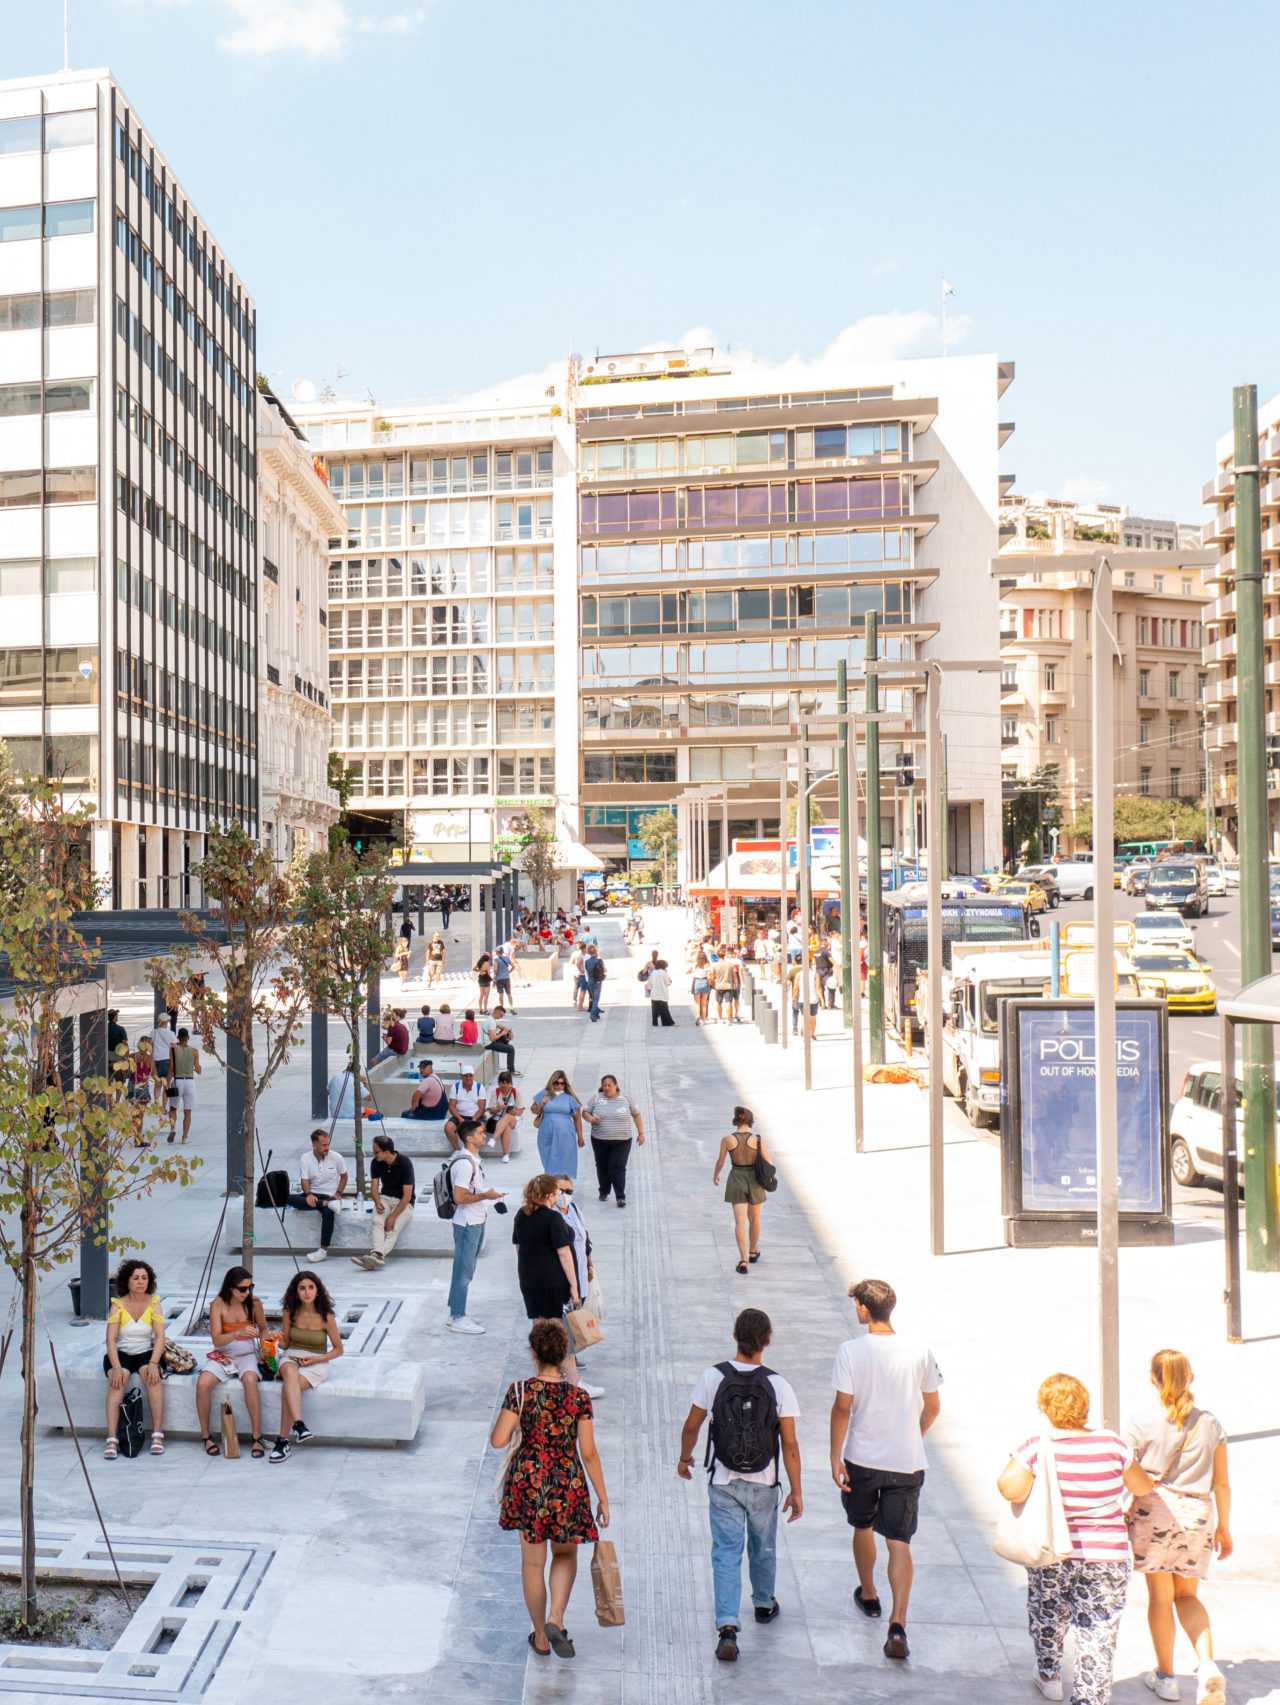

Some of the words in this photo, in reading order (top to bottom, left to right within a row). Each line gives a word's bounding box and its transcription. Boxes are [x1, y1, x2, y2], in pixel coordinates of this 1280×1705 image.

[1040, 1039, 1140, 1061] POLIS
[1040, 1066, 1060, 1077] OUT
[1061, 1066, 1075, 1077] OF
[1116, 1067, 1140, 1077] EDIA
